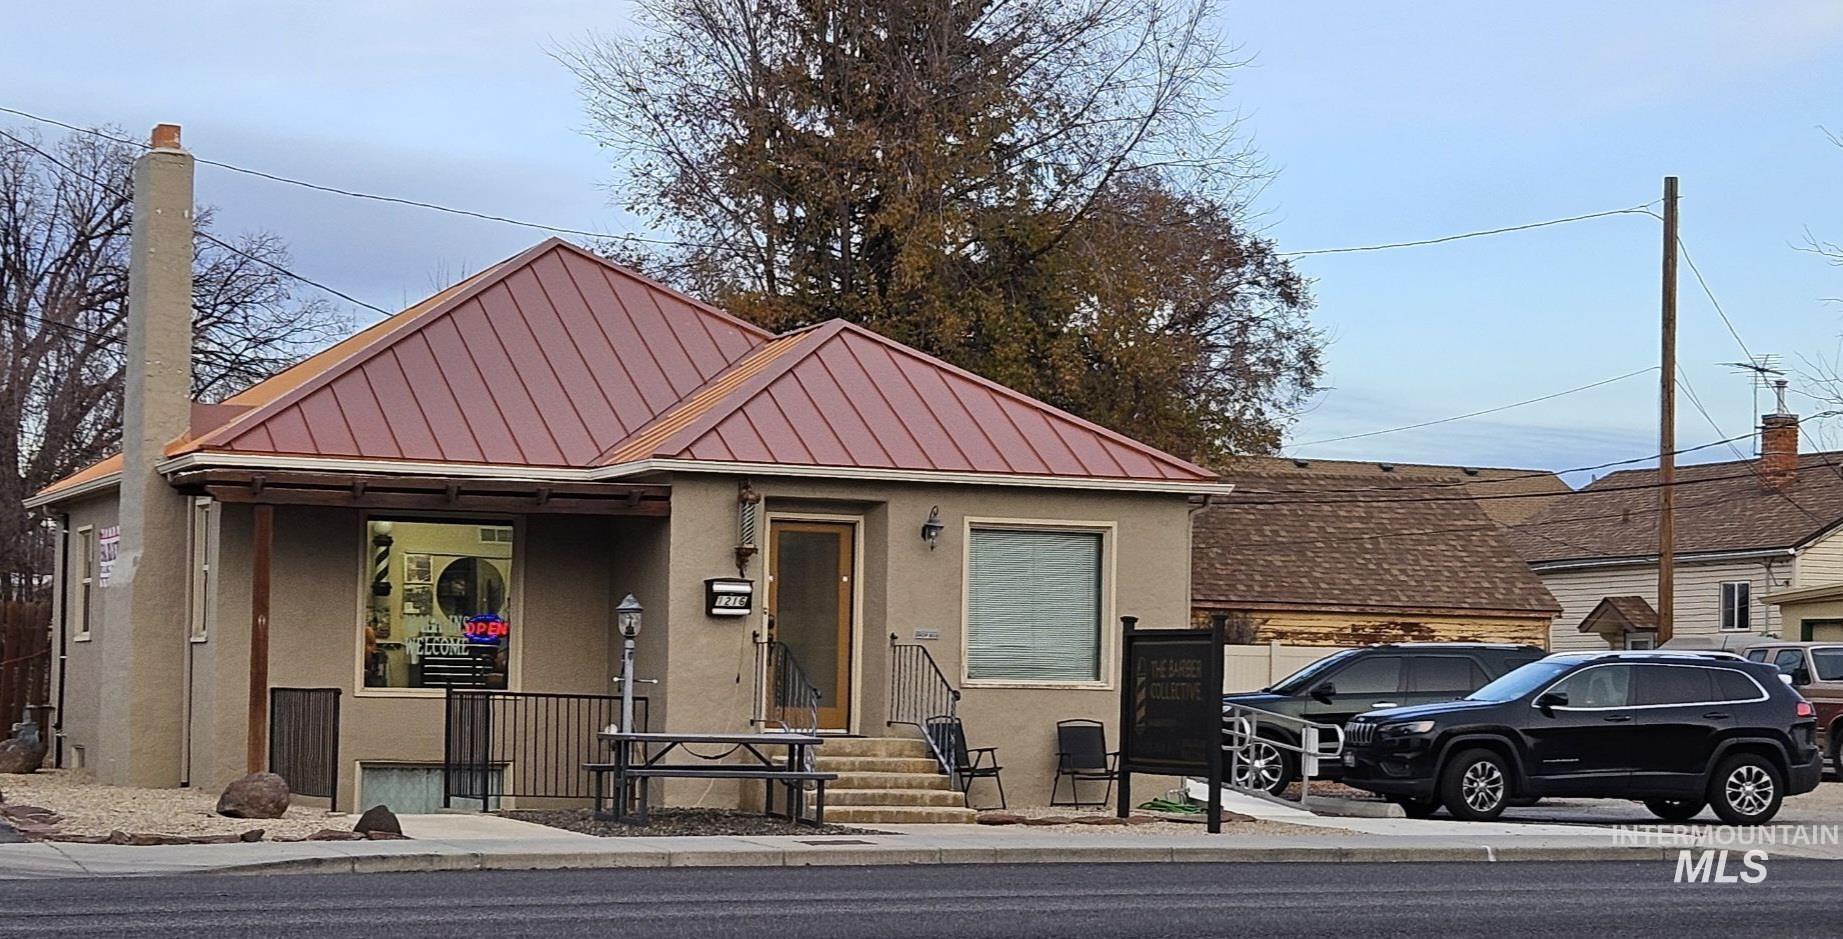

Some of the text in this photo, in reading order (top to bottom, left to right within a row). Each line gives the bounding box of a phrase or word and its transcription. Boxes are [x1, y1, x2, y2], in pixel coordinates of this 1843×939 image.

[717, 596, 746, 607] 1216
[465, 621, 508, 636] OPEN
[405, 637, 470, 656] WELCOME
[1151, 659, 1167, 678] THE
